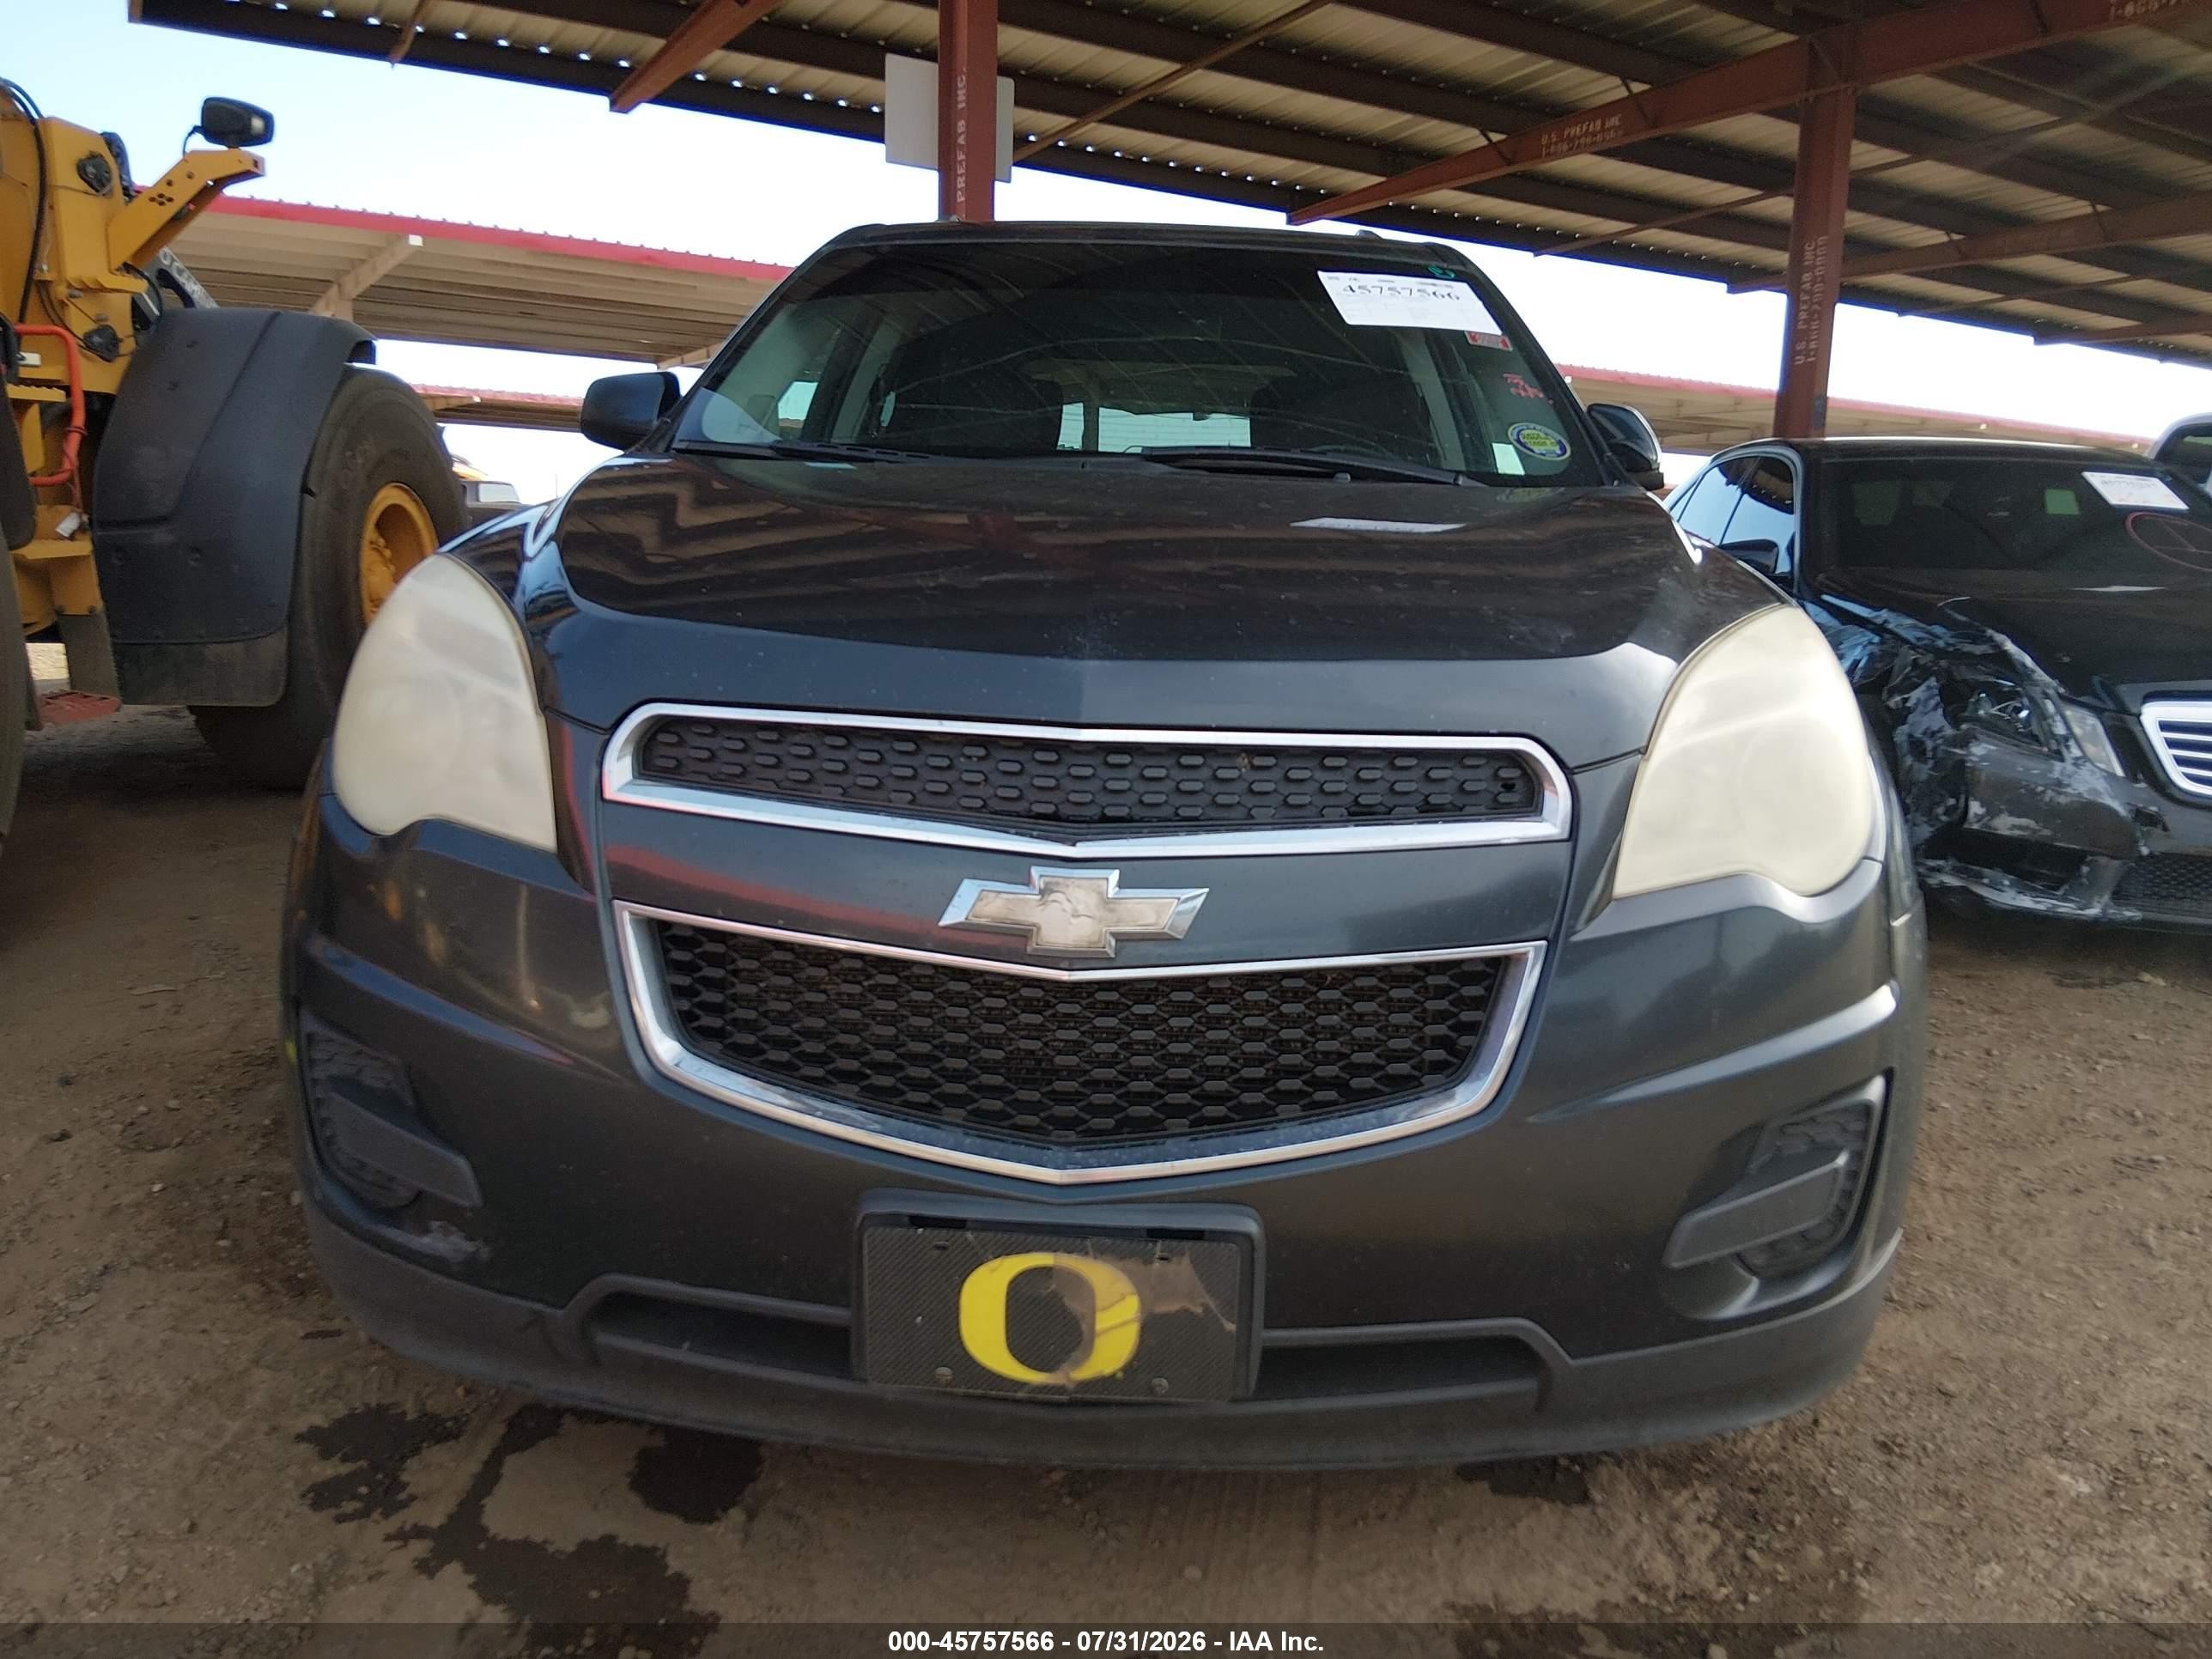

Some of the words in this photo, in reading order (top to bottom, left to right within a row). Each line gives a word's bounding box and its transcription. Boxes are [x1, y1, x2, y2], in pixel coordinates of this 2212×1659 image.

[1564, 118, 1602, 138] PREFAB
[957, 118, 966, 203] PREFAB
[1343, 284, 1461, 301] 45757566
[1797, 272, 1814, 329] PREFAB
[958, 1251, 1141, 1385] O
